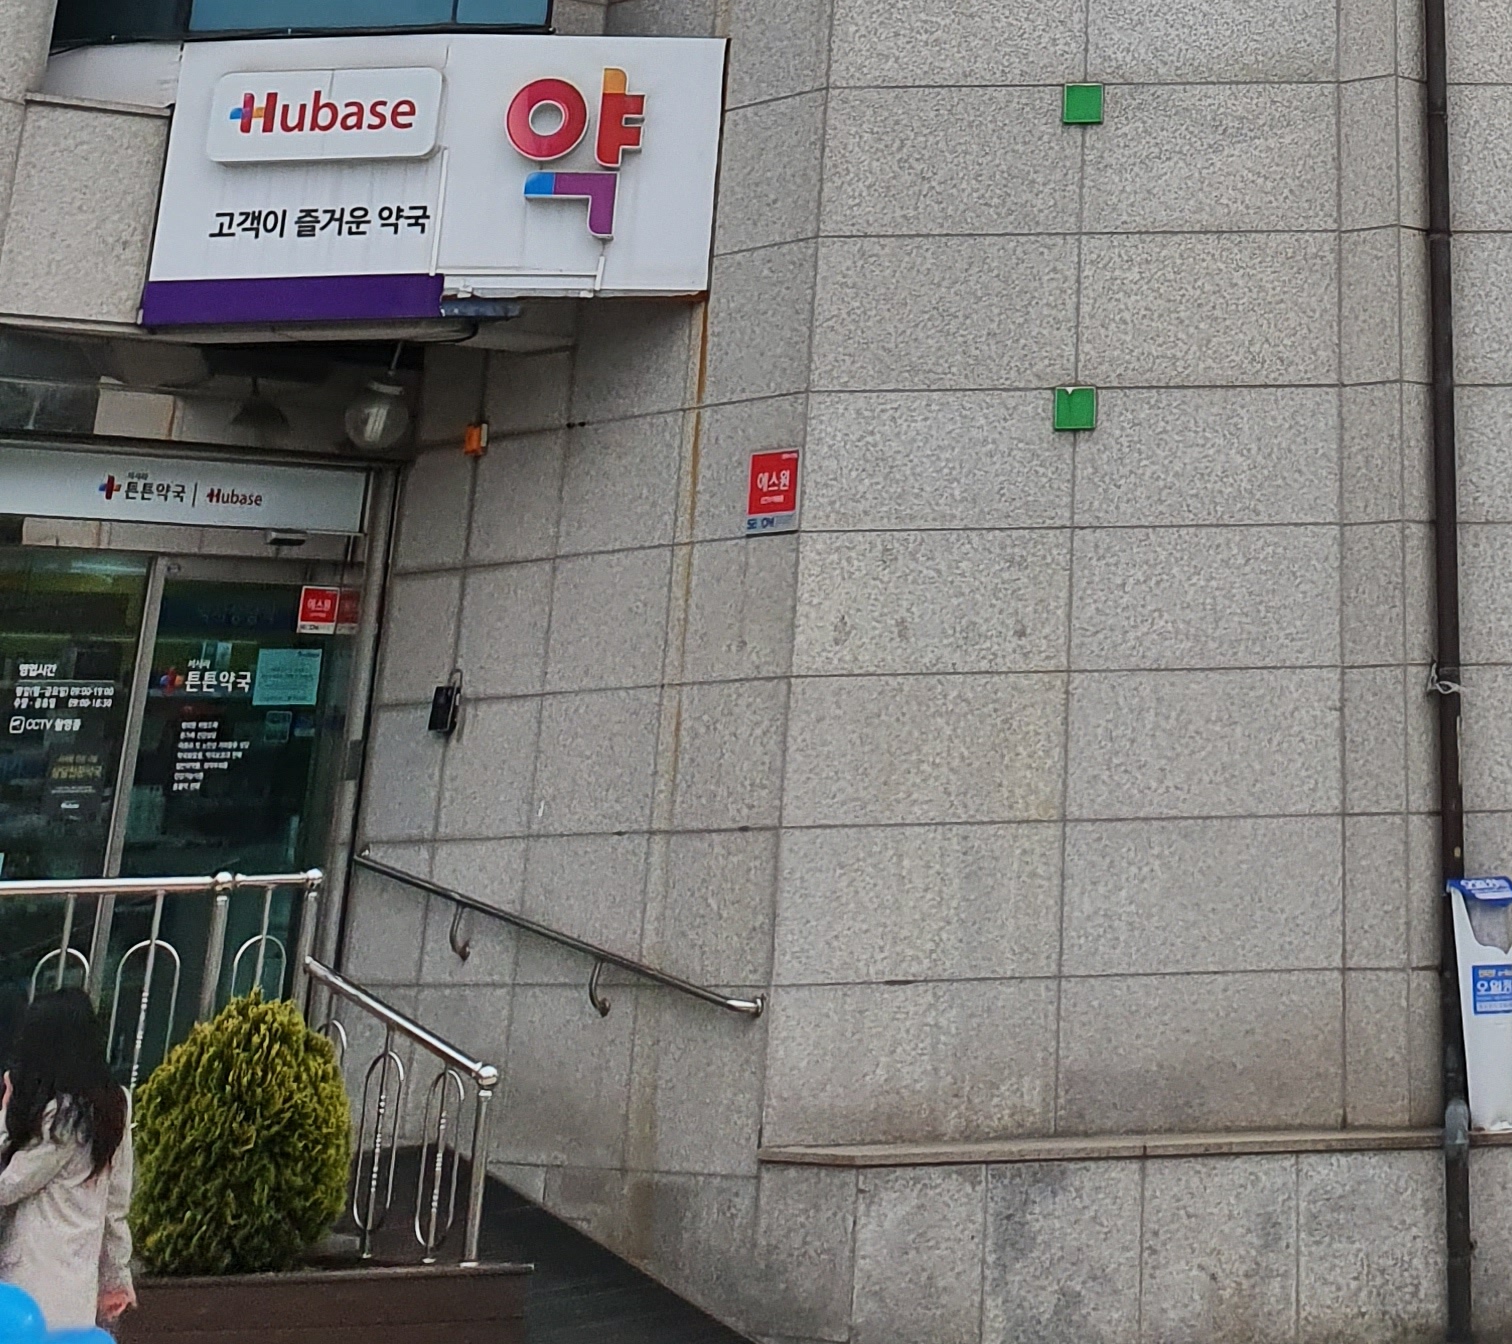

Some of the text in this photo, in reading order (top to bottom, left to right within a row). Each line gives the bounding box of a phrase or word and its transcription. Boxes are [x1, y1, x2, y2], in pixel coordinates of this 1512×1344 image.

[229, 89, 417, 134] Hubase
[504, 67, 646, 240] 약
[208, 204, 431, 240] 고객이 즐거운 약국
[124, 480, 263, 507] 튼튼약국 Hubase
[185, 670, 252, 693] 튼튼약국
[26, 718, 53, 731] CCTV
